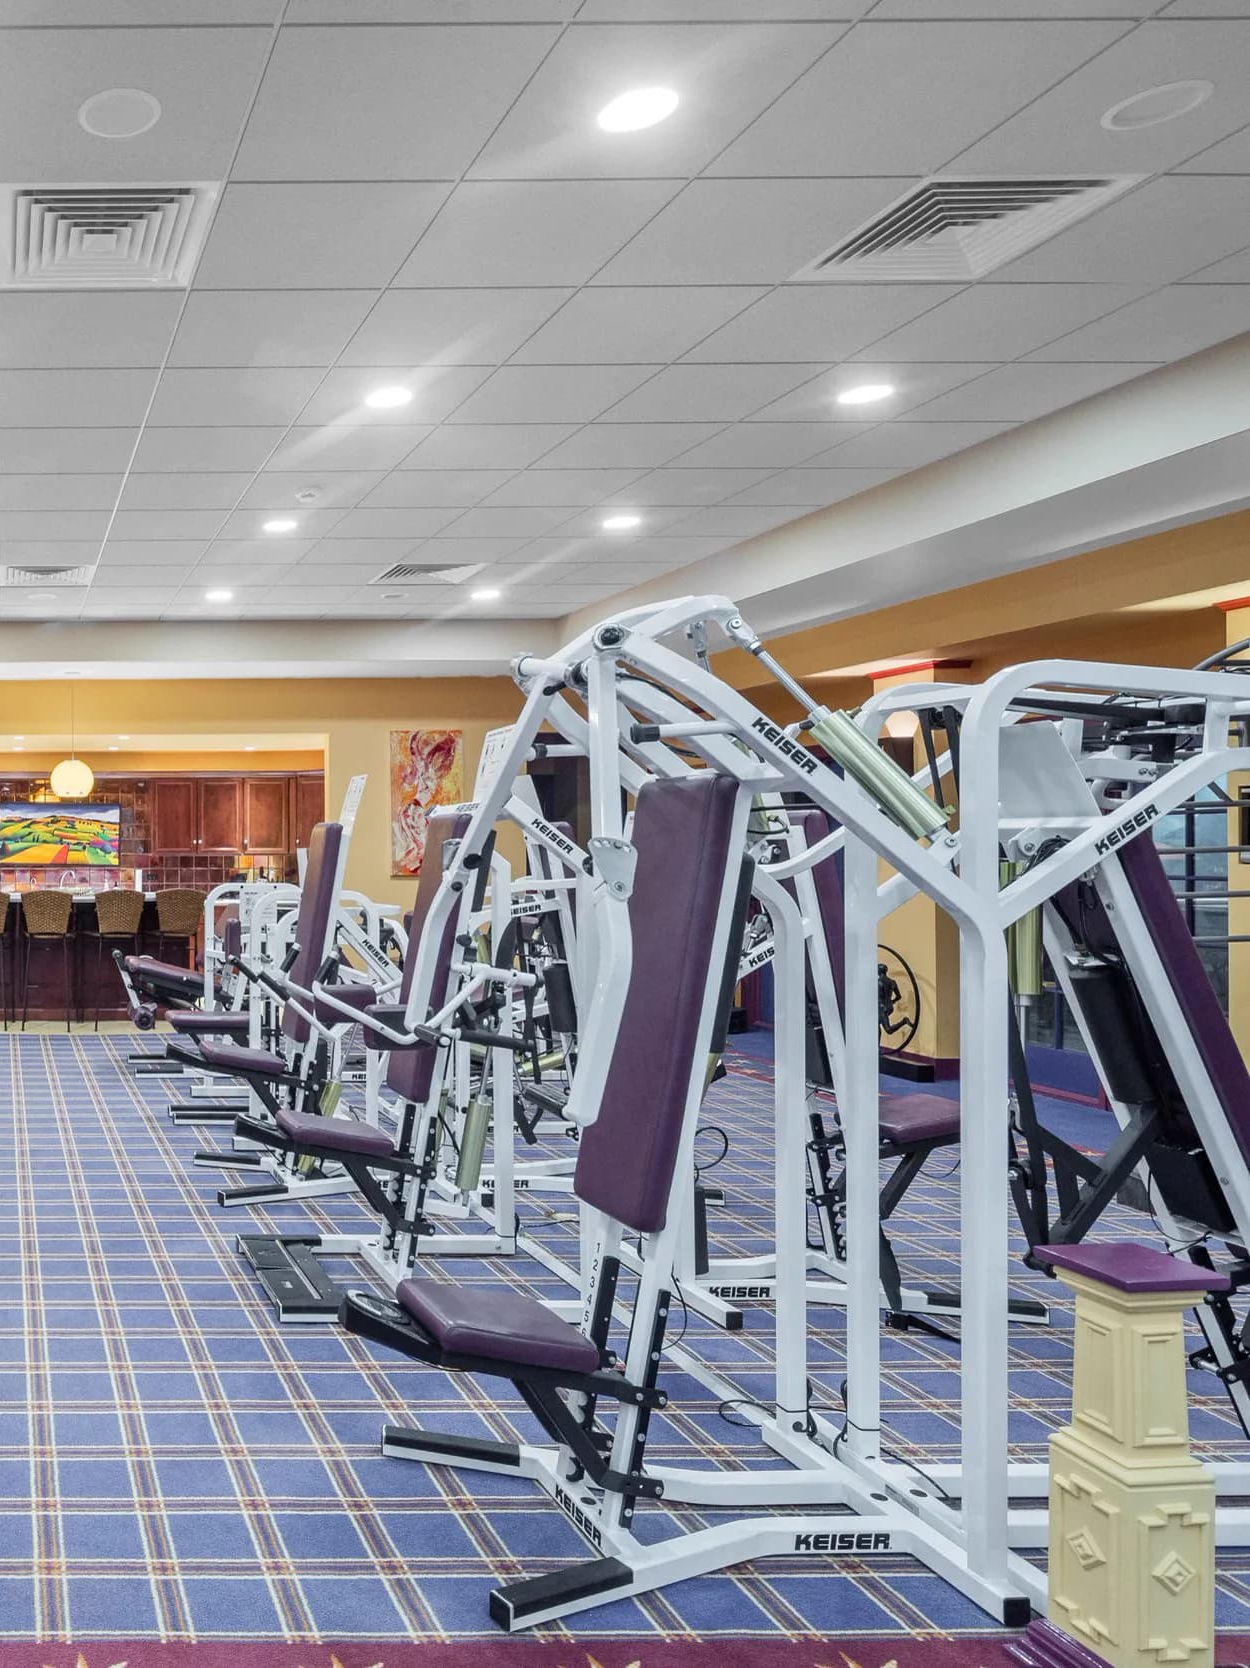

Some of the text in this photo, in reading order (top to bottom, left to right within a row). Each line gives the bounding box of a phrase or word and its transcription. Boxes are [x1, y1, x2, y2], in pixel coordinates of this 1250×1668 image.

[751, 716, 818, 776] KEISER
[531, 818, 574, 854] KEISER
[1094, 803, 1159, 856] KEISER
[510, 904, 541, 917] EISER
[362, 939, 389, 968] KEISER
[748, 946, 775, 967] KEIS
[592, 1259, 599, 1271] 2
[589, 1276, 595, 1288] 3
[587, 1294, 592, 1305] 4
[709, 1286, 770, 1298] KEISER
[584, 1310, 590, 1322] 5
[555, 1484, 602, 1548] KEISER
[794, 1533, 891, 1550] KEISER
